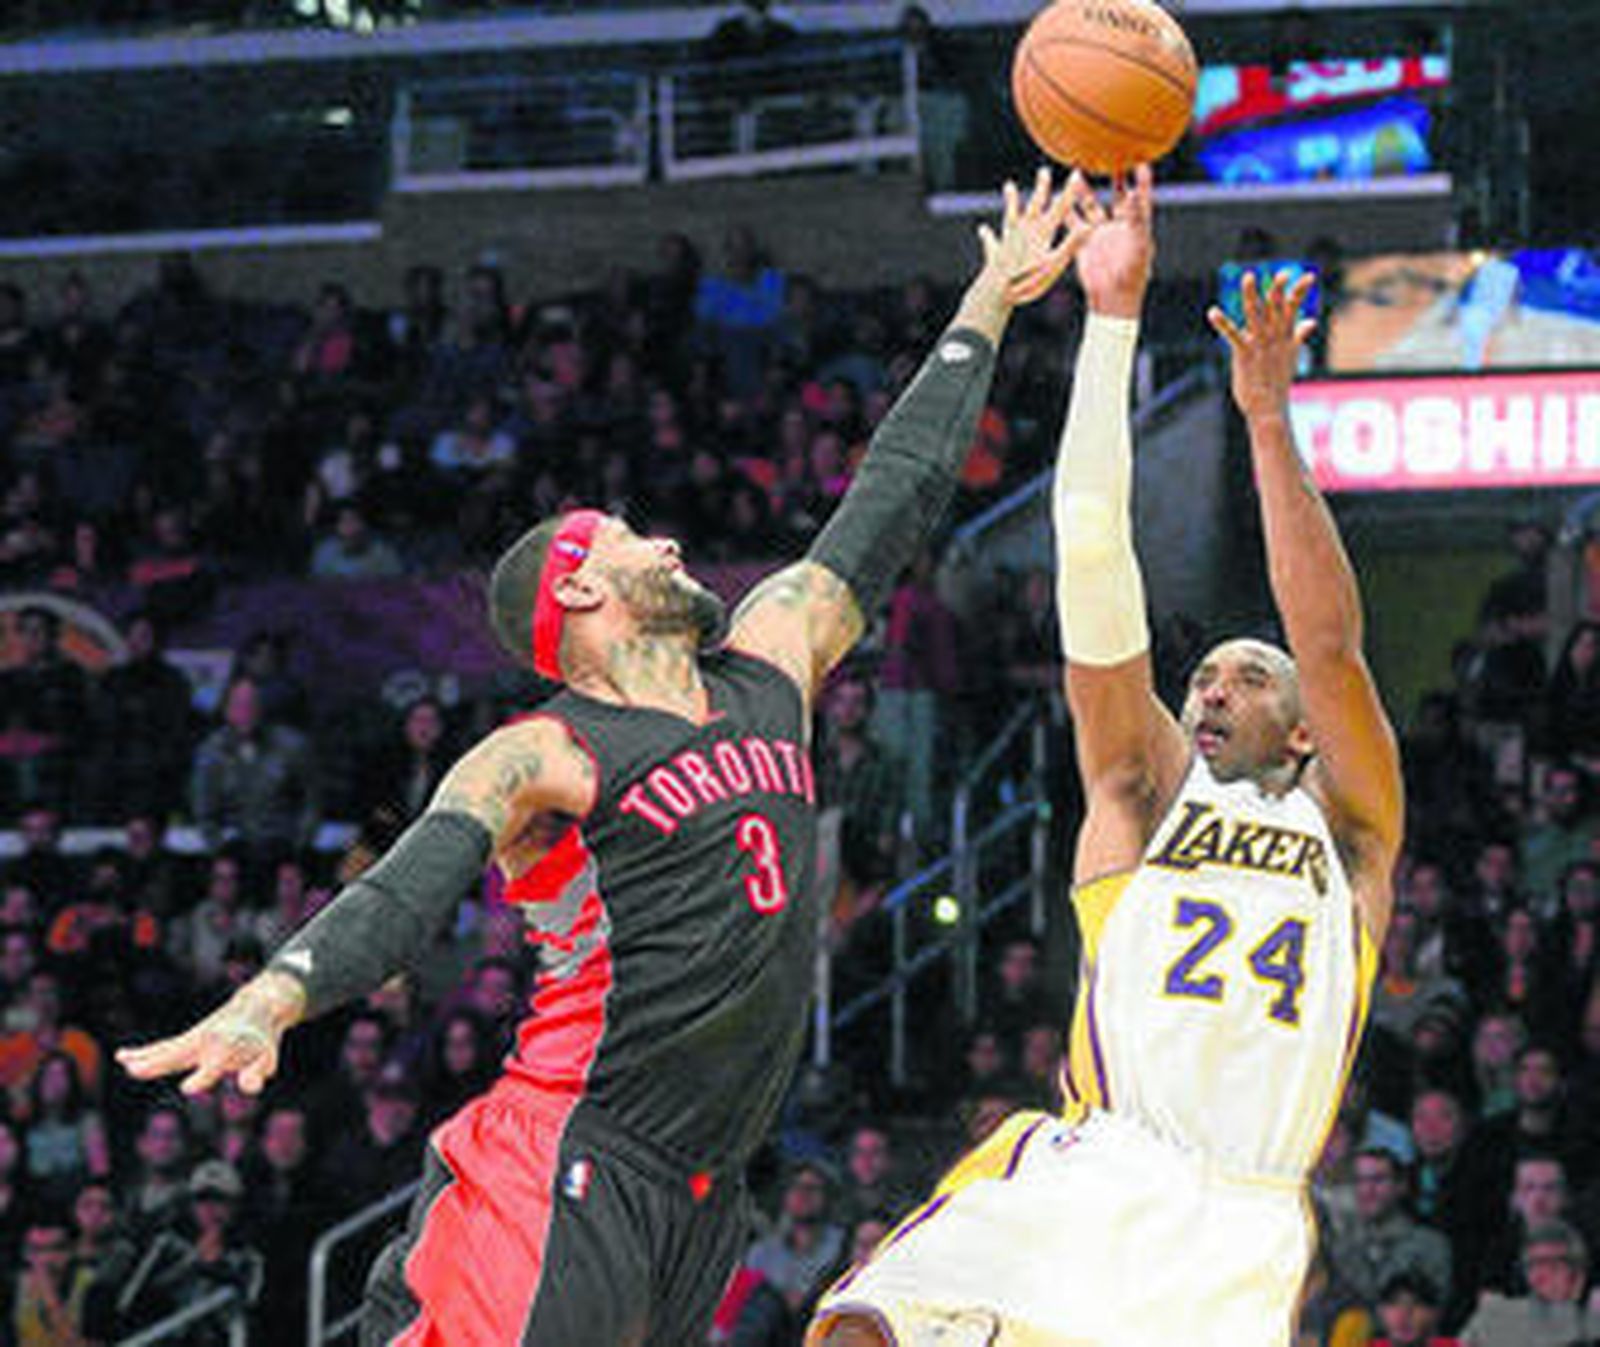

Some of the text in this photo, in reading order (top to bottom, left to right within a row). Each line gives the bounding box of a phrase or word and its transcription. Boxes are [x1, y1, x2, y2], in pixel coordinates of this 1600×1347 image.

[618, 737, 815, 835] TORONT
[735, 812, 787, 915] 3
[1146, 800, 1329, 897] LAKER
[1164, 897, 1312, 1028] 24
